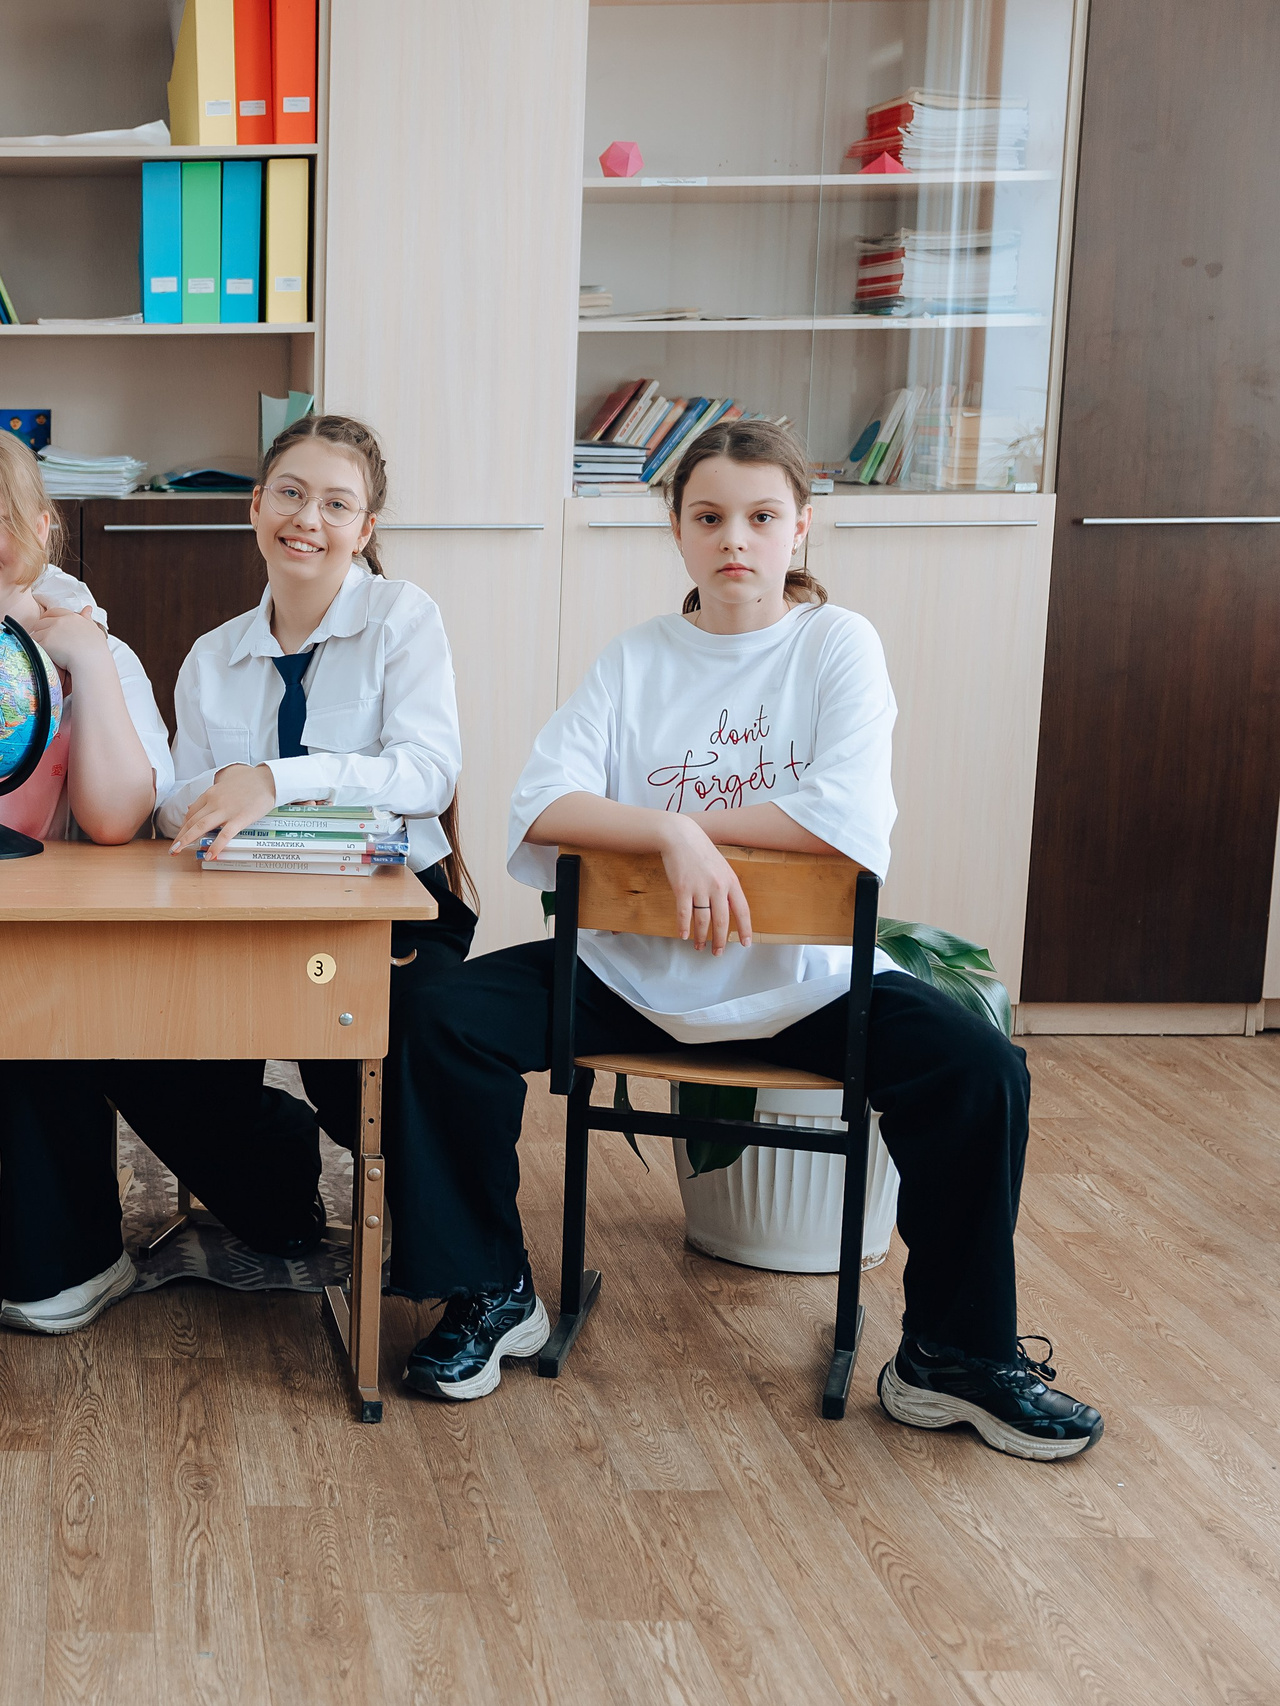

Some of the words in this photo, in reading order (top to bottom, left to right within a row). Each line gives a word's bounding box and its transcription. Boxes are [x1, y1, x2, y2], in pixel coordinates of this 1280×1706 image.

[647, 745, 776, 813] Forget
[274, 819, 328, 828] ТЕХНОЛОГИЯ
[255, 861, 309, 870] ТЕХНОЛОГИЯ
[313, 960, 324, 977] 3
